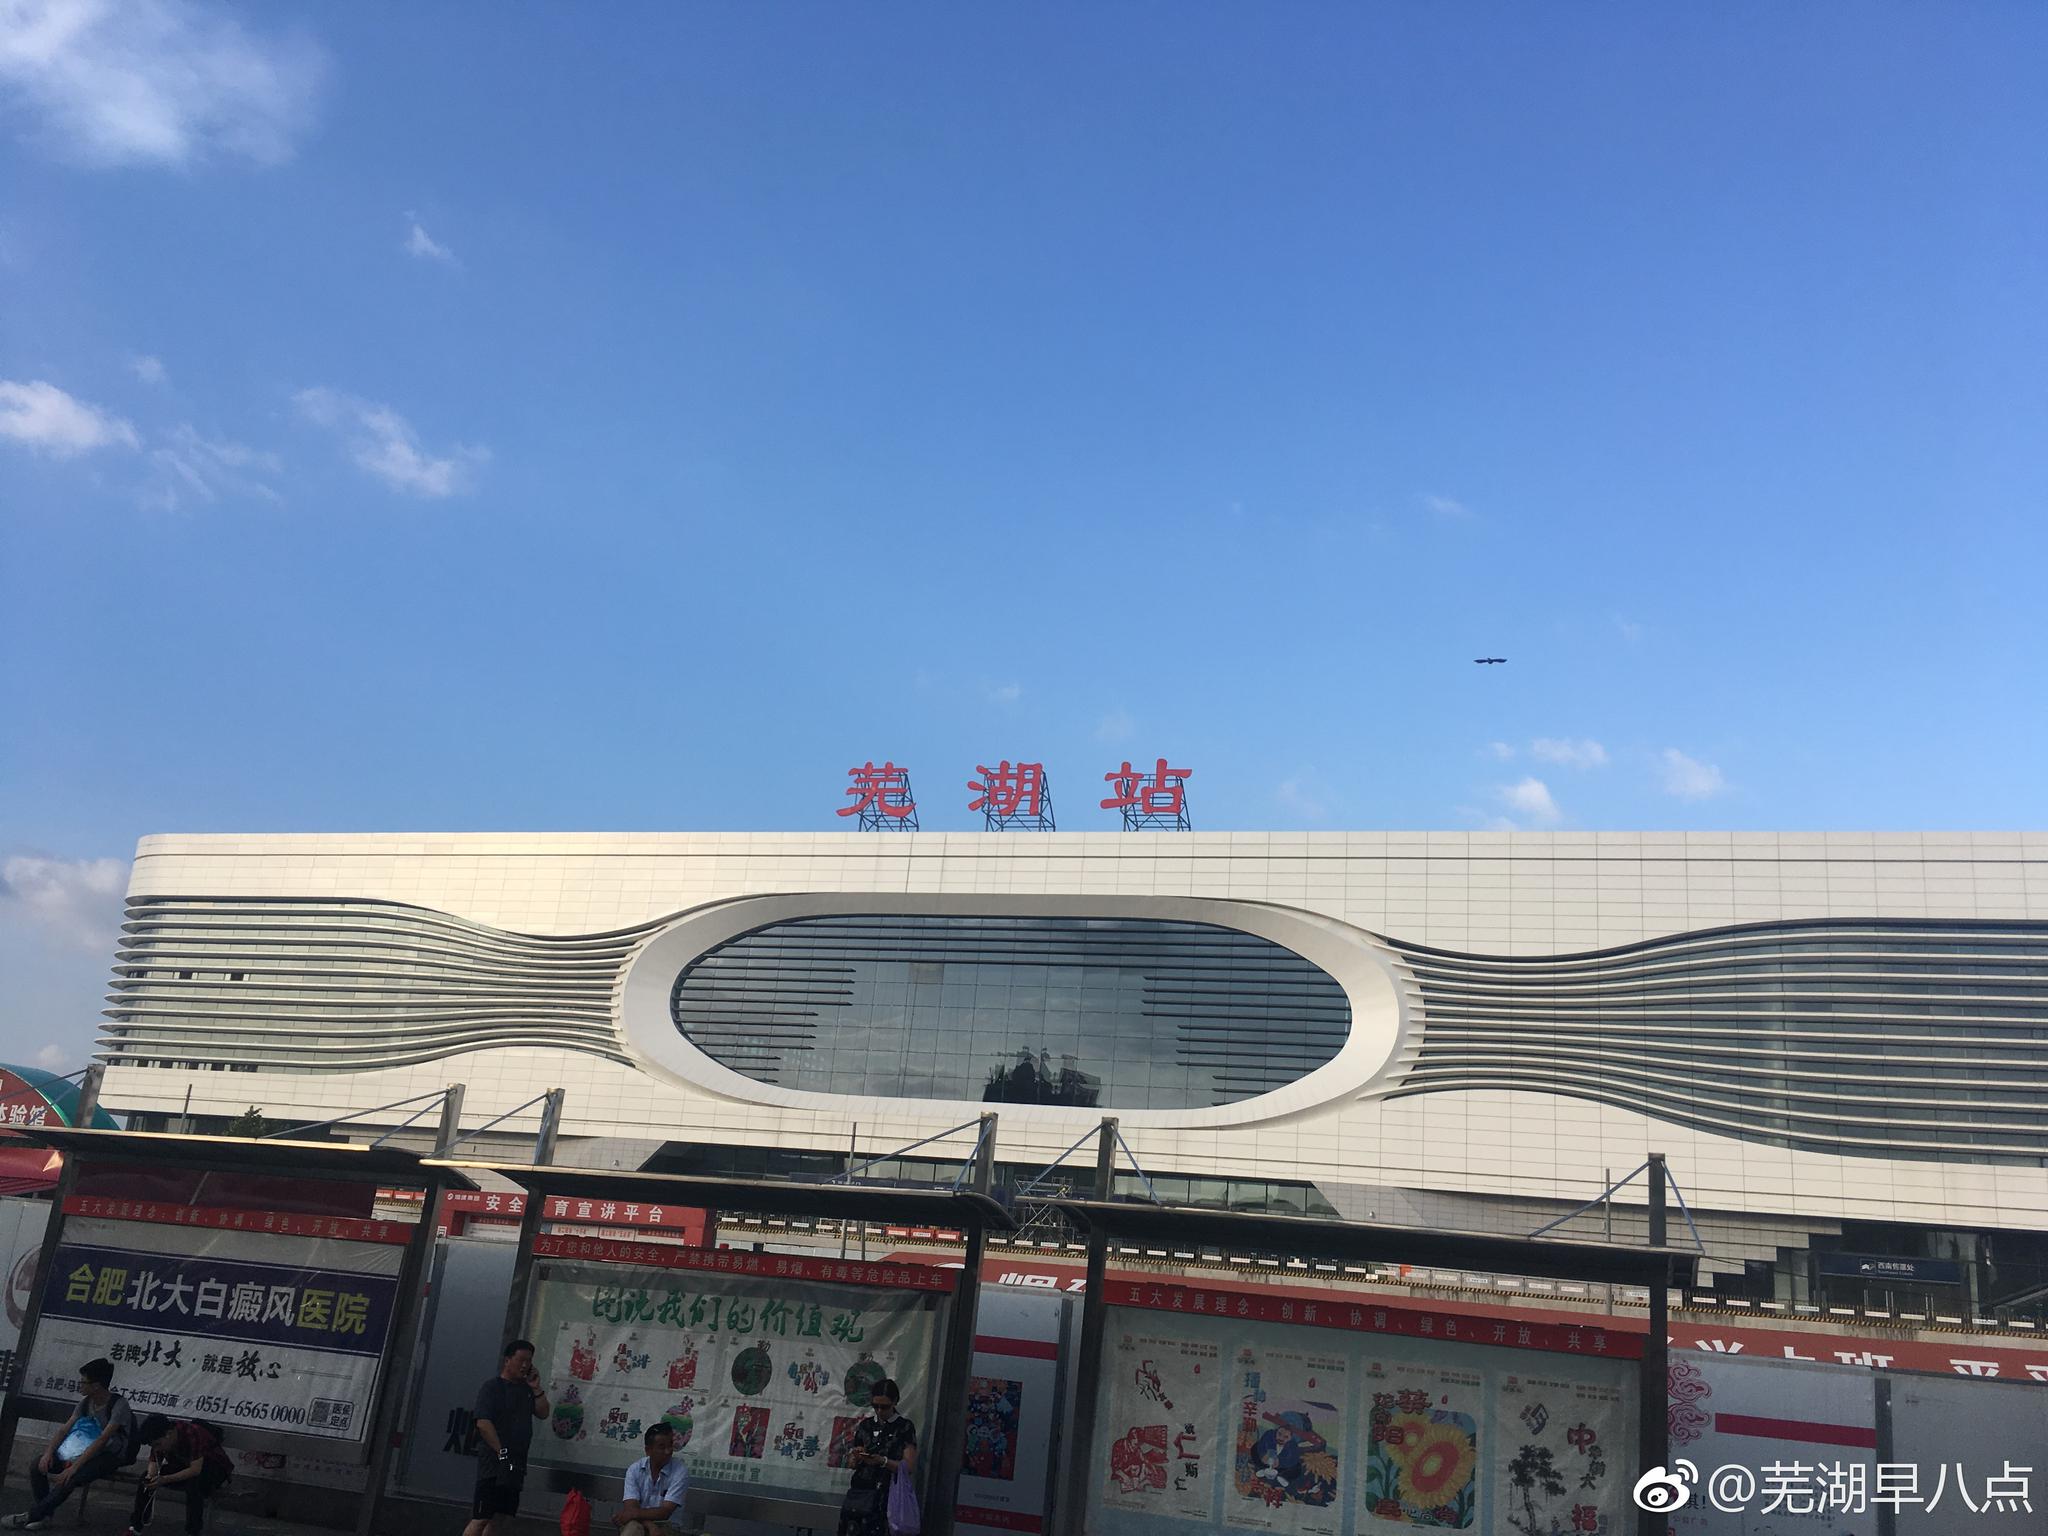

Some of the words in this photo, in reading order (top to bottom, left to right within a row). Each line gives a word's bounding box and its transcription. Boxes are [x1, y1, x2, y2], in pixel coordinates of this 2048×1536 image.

[835, 759, 1193, 818] 芜湖站
[64, 1263, 370, 1335] 合肥北大白癜风医院
[592, 1286, 864, 1343] 图说我们的价值观
[195, 1395, 269, 1419] 0551-6565
